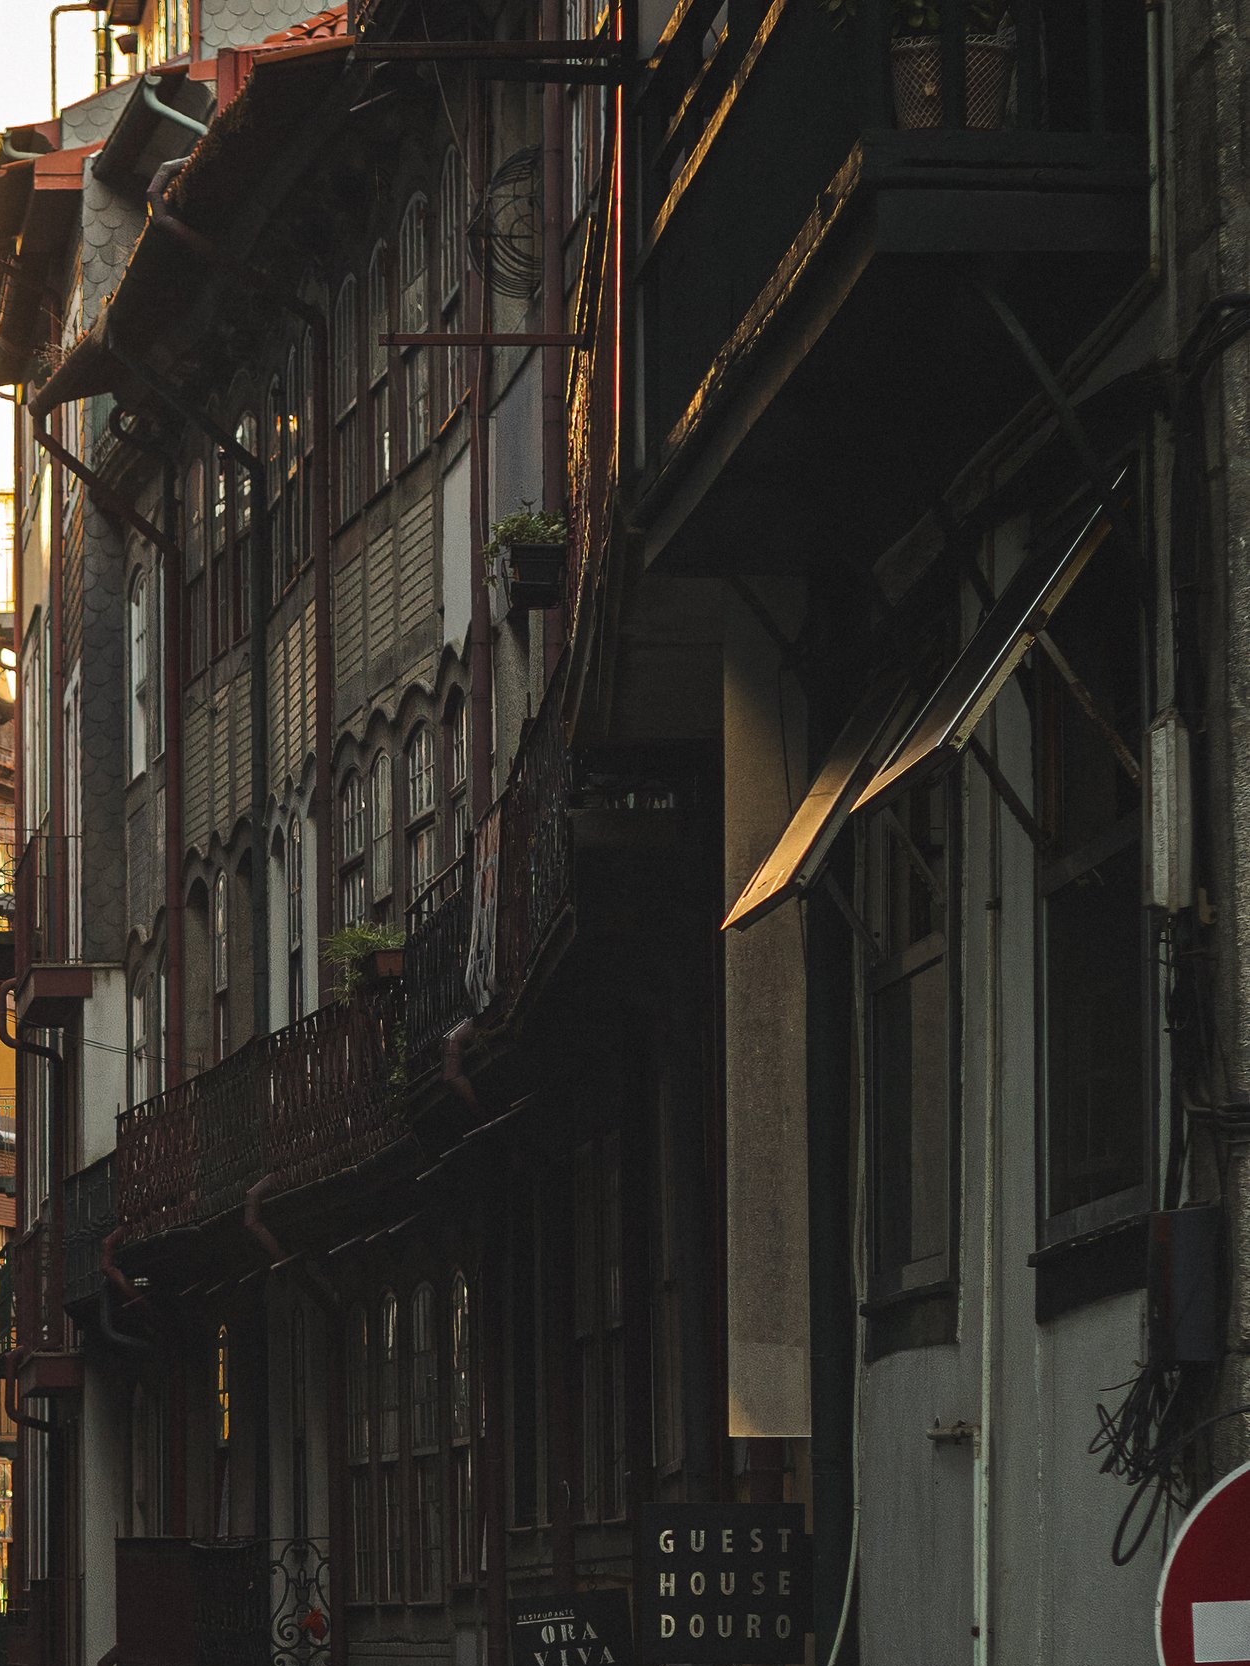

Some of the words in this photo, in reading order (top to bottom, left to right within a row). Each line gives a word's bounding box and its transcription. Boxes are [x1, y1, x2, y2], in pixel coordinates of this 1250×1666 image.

[659, 1528, 792, 1553] GUEST
[660, 1570, 791, 1596] HOUSE
[517, 1608, 574, 1622] RESTAURANTE
[660, 1613, 791, 1638] DOURO
[541, 1620, 598, 1645] ORA
